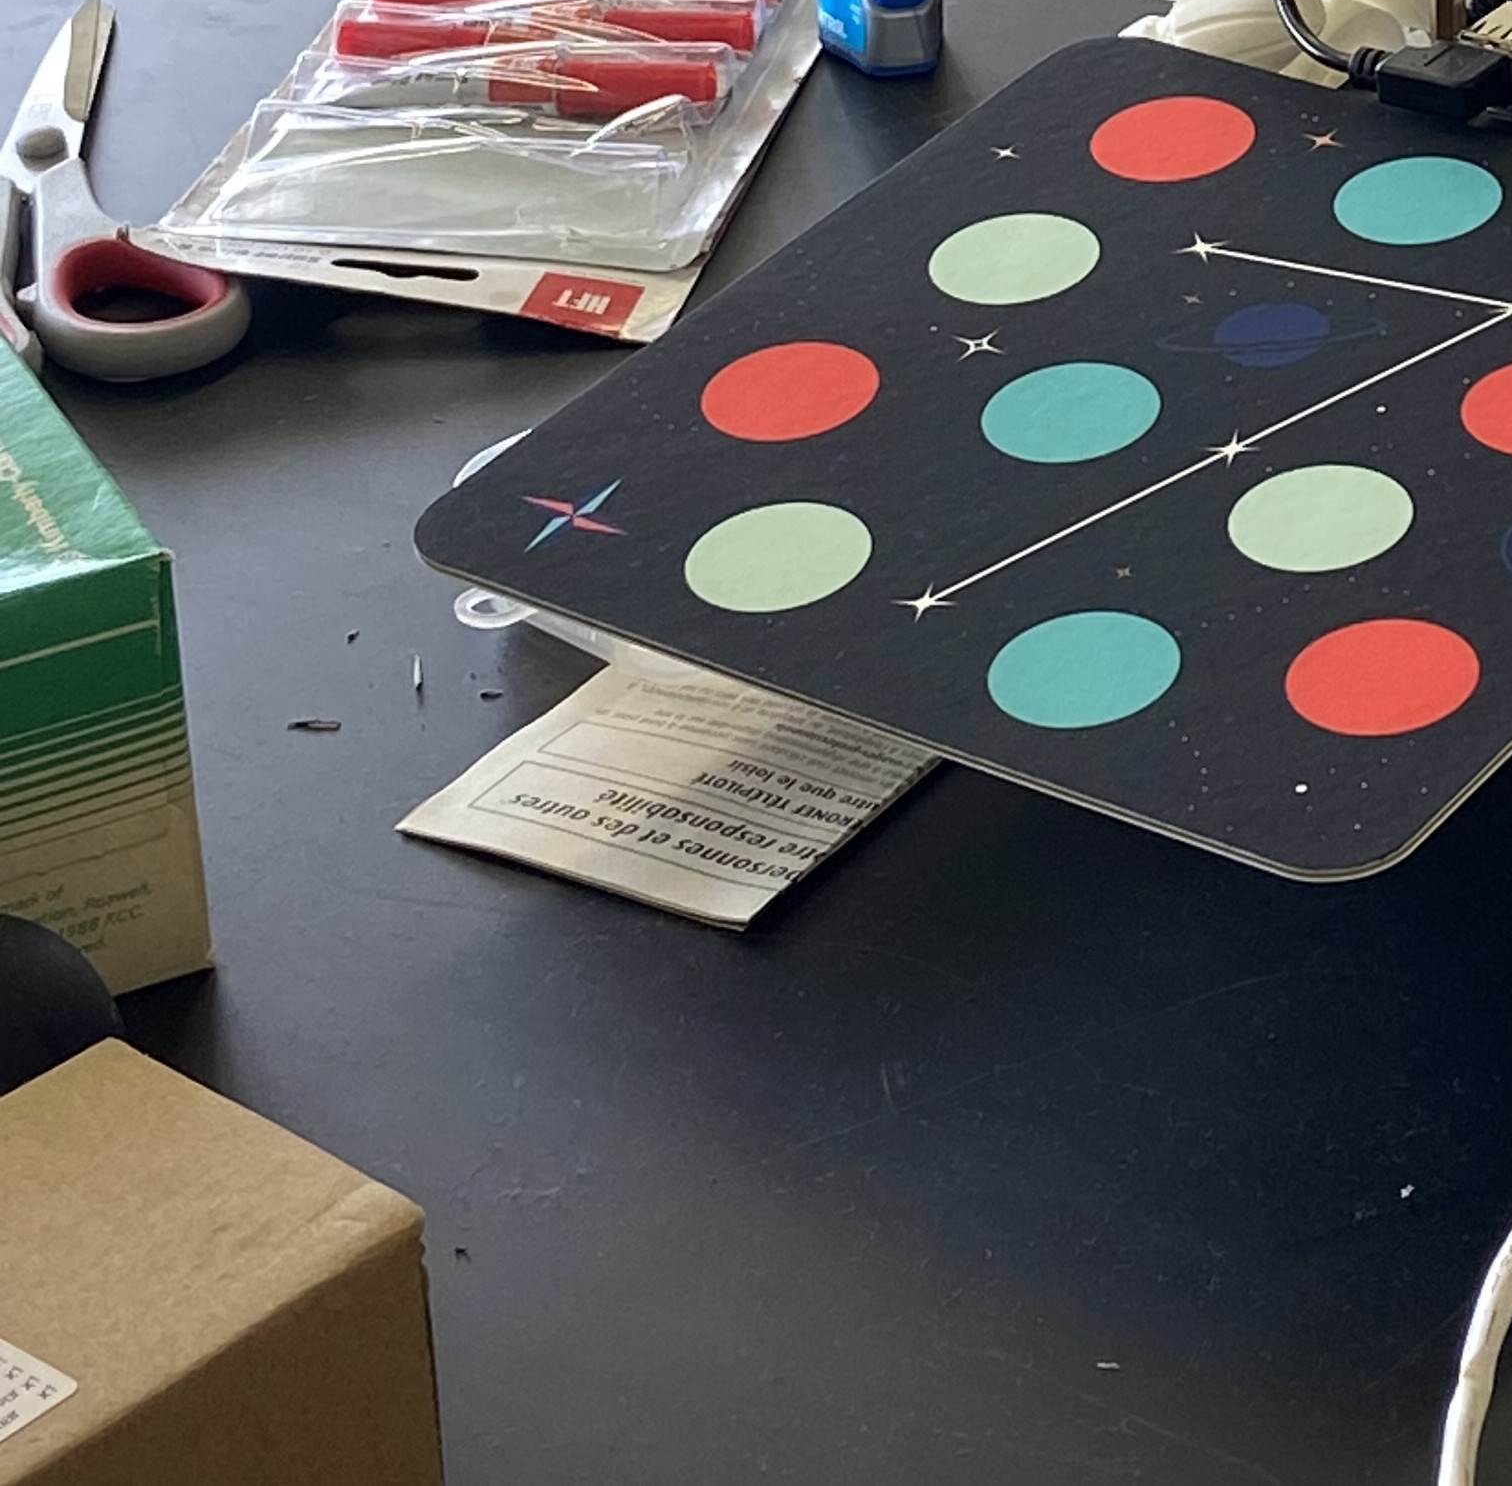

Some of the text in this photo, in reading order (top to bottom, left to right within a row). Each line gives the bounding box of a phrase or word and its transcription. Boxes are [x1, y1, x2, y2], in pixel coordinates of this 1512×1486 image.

[552, 287, 612, 315] HFT
[727, 759, 881, 812] utre que le loisir
[511, 792, 803, 885] personnes et des autres
[594, 789, 778, 850] responsabilité
[791, 803, 865, 831] RONEF
